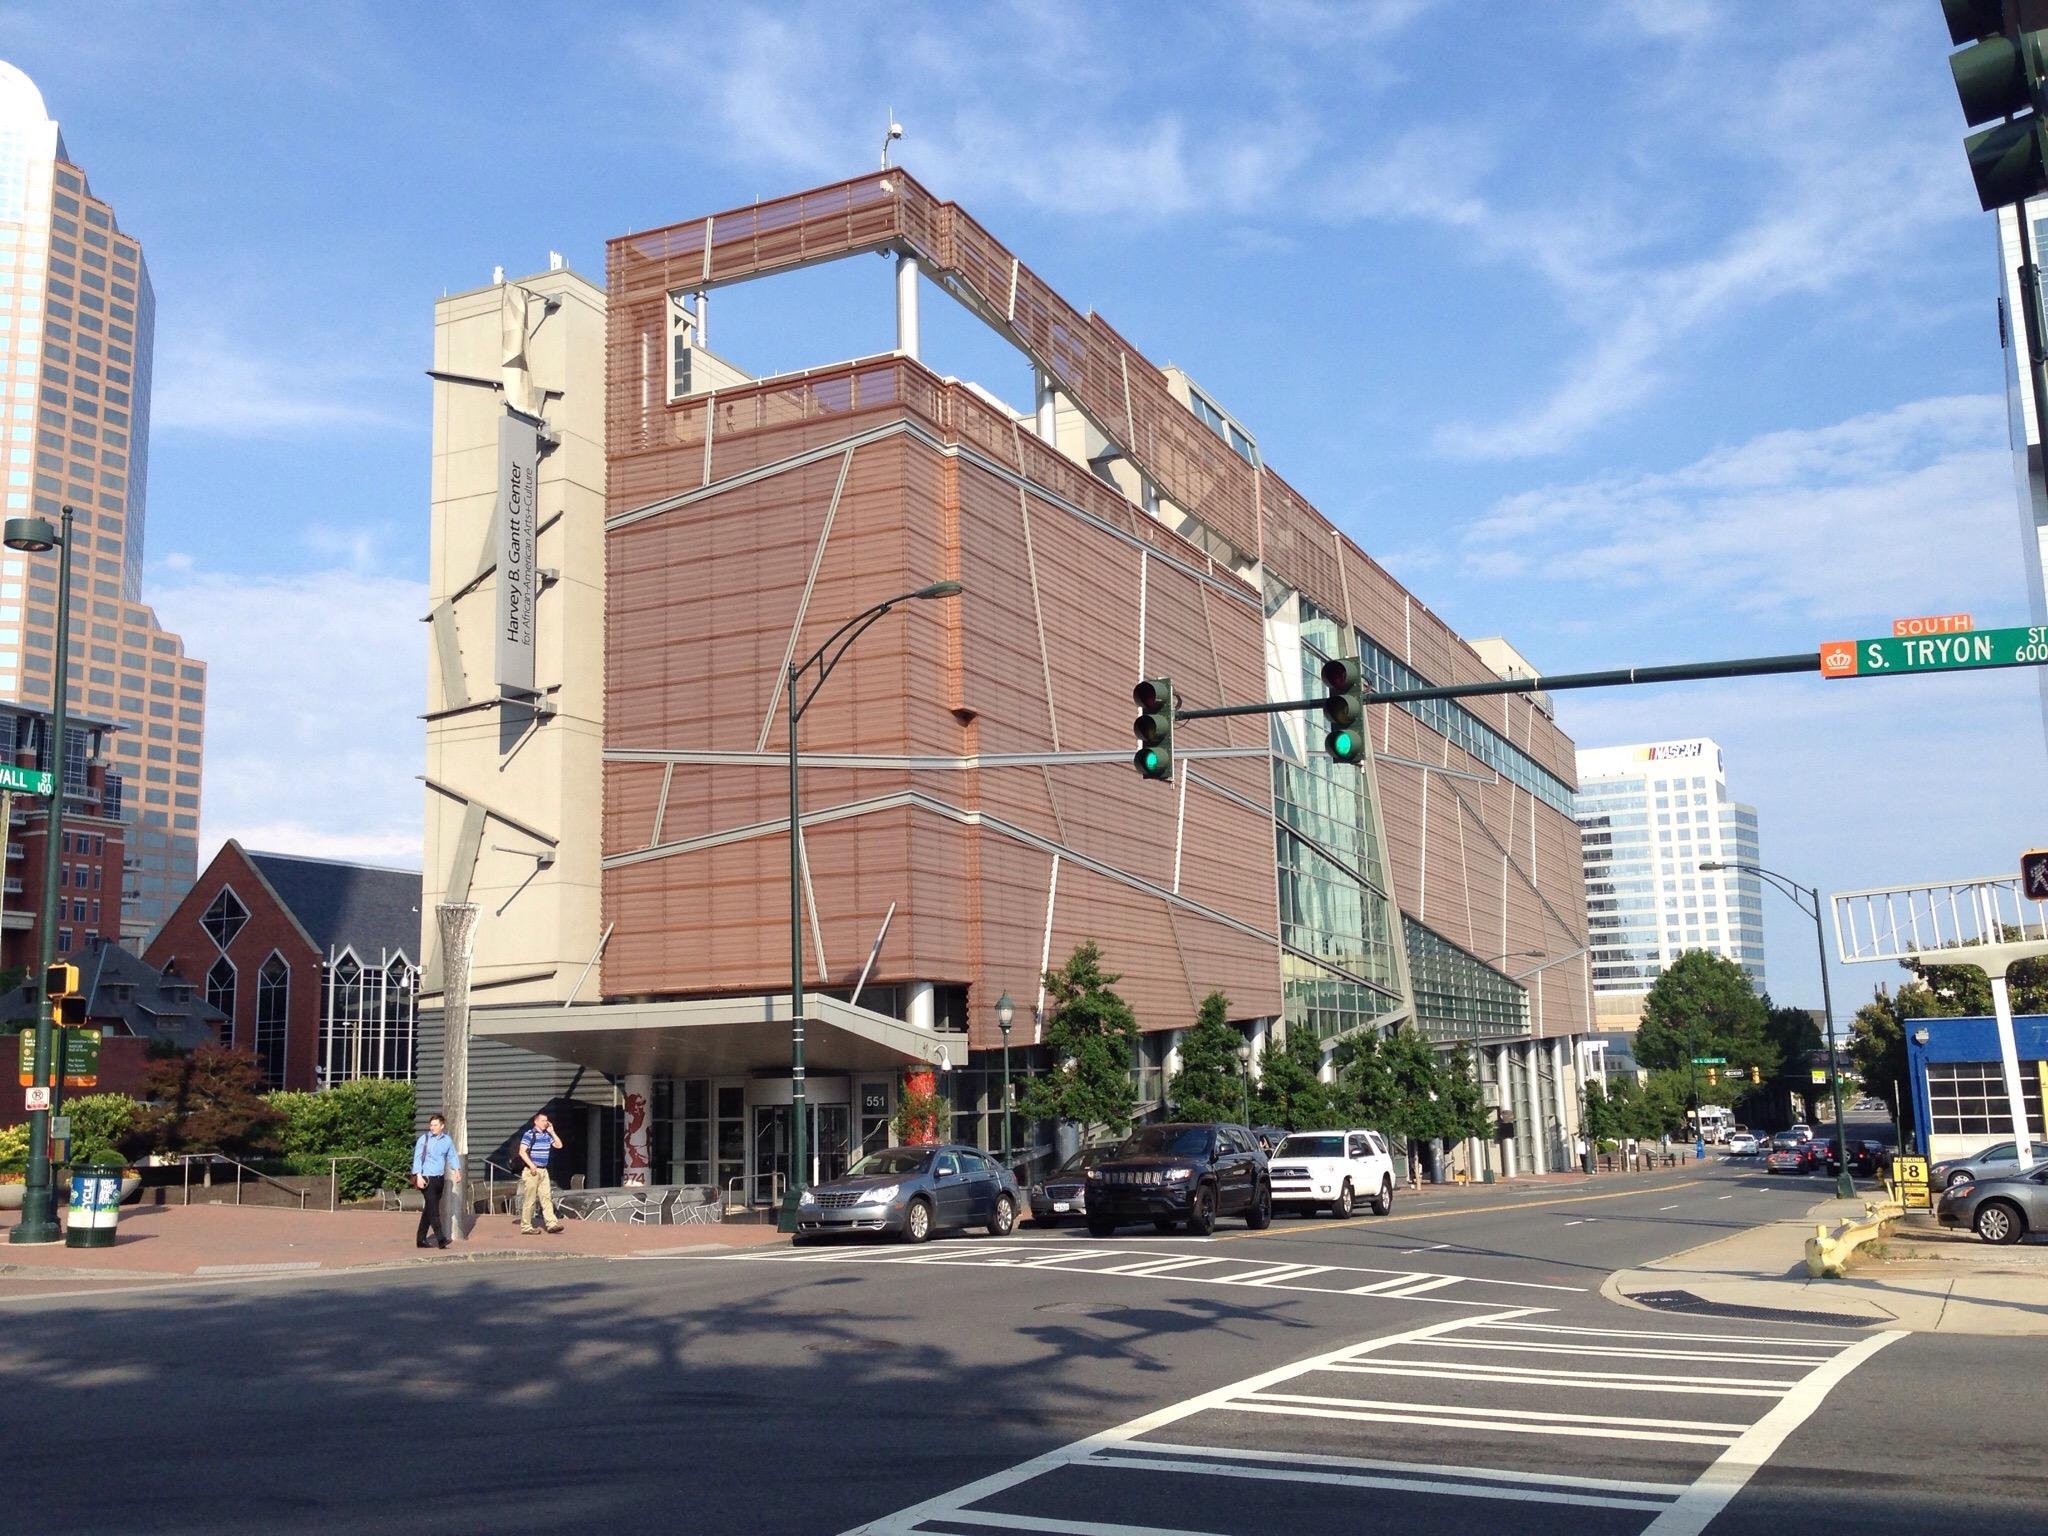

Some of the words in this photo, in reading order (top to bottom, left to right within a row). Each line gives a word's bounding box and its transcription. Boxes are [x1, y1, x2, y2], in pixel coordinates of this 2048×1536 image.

[509, 461, 521, 515] Center
[524, 467, 533, 536] Arts+Culture
[508, 518, 521, 564] Gantt
[508, 569, 520, 582] B.
[522, 538, 533, 629] African-American
[507, 584, 522, 643] Harvey
[1896, 615, 1968, 636] SOUTH
[521, 630, 531, 646] for
[1868, 643, 1890, 669] S.
[1902, 636, 1991, 666] TRYON
[2028, 627, 2047, 644] ST
[2015, 643, 2048, 662] 600
[37, 782, 52, 794] 100
[41, 772, 52, 784] ST
[866, 1095, 885, 1107] 551
